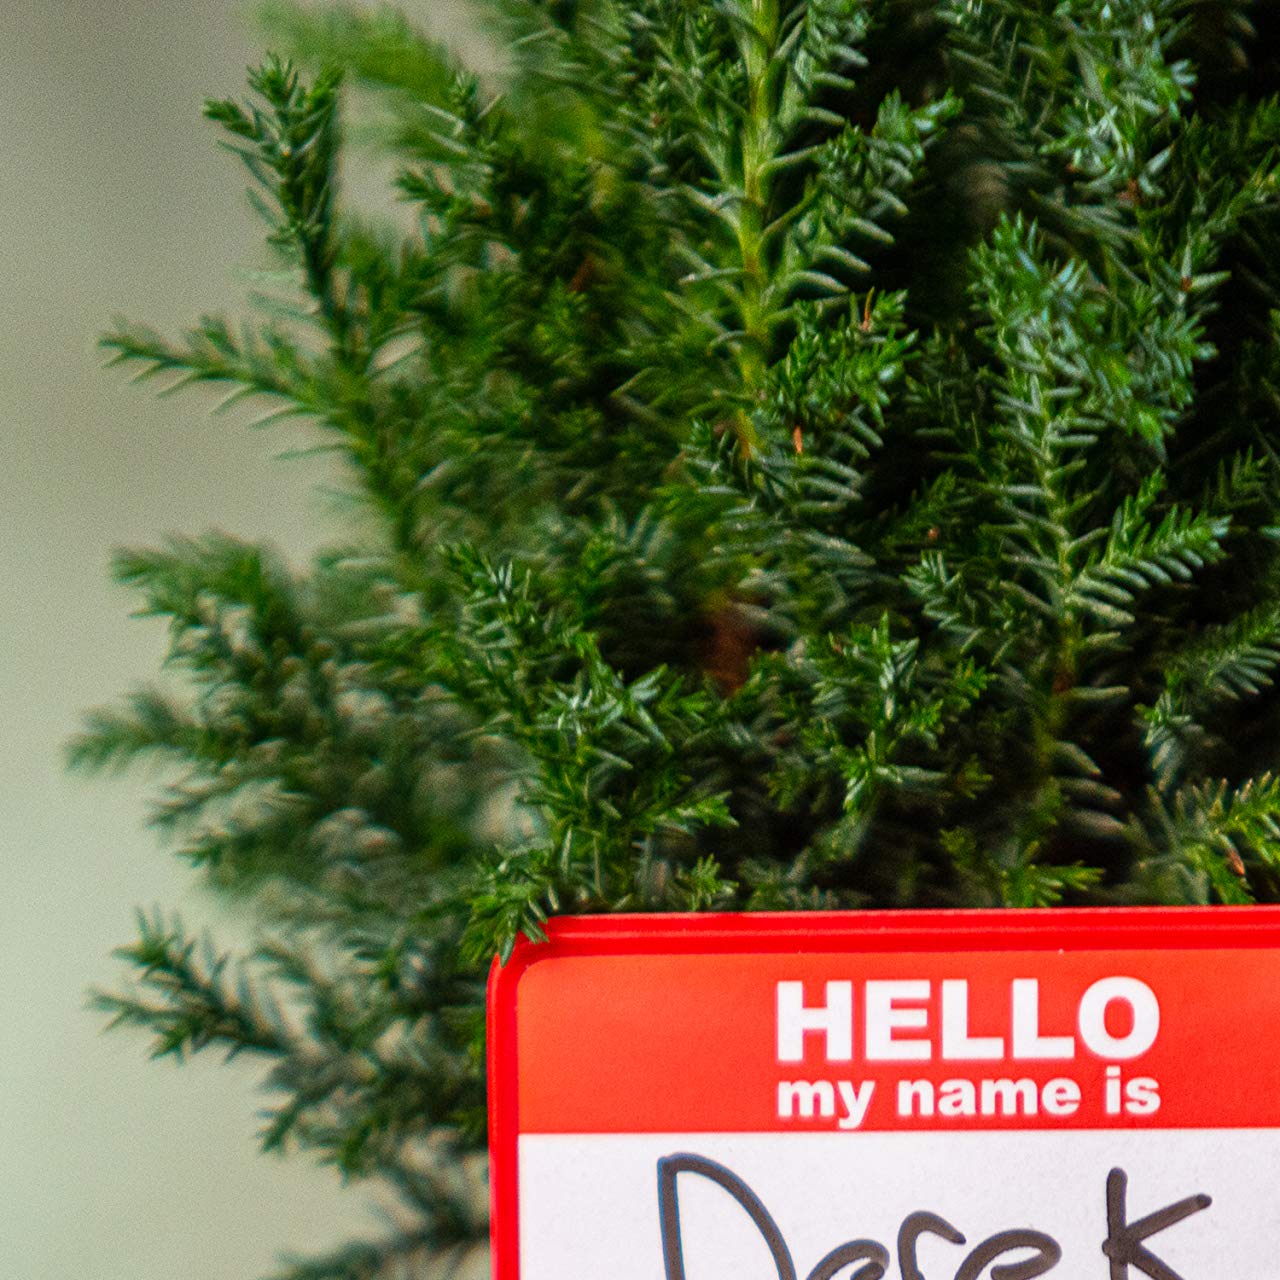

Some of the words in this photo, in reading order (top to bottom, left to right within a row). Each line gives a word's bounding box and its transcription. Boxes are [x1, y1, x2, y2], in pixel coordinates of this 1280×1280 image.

[776, 976, 1162, 1062] HELLO
[776, 1079, 877, 1131] my
[896, 1077, 1082, 1118] name
[1104, 1066, 1162, 1116] is
